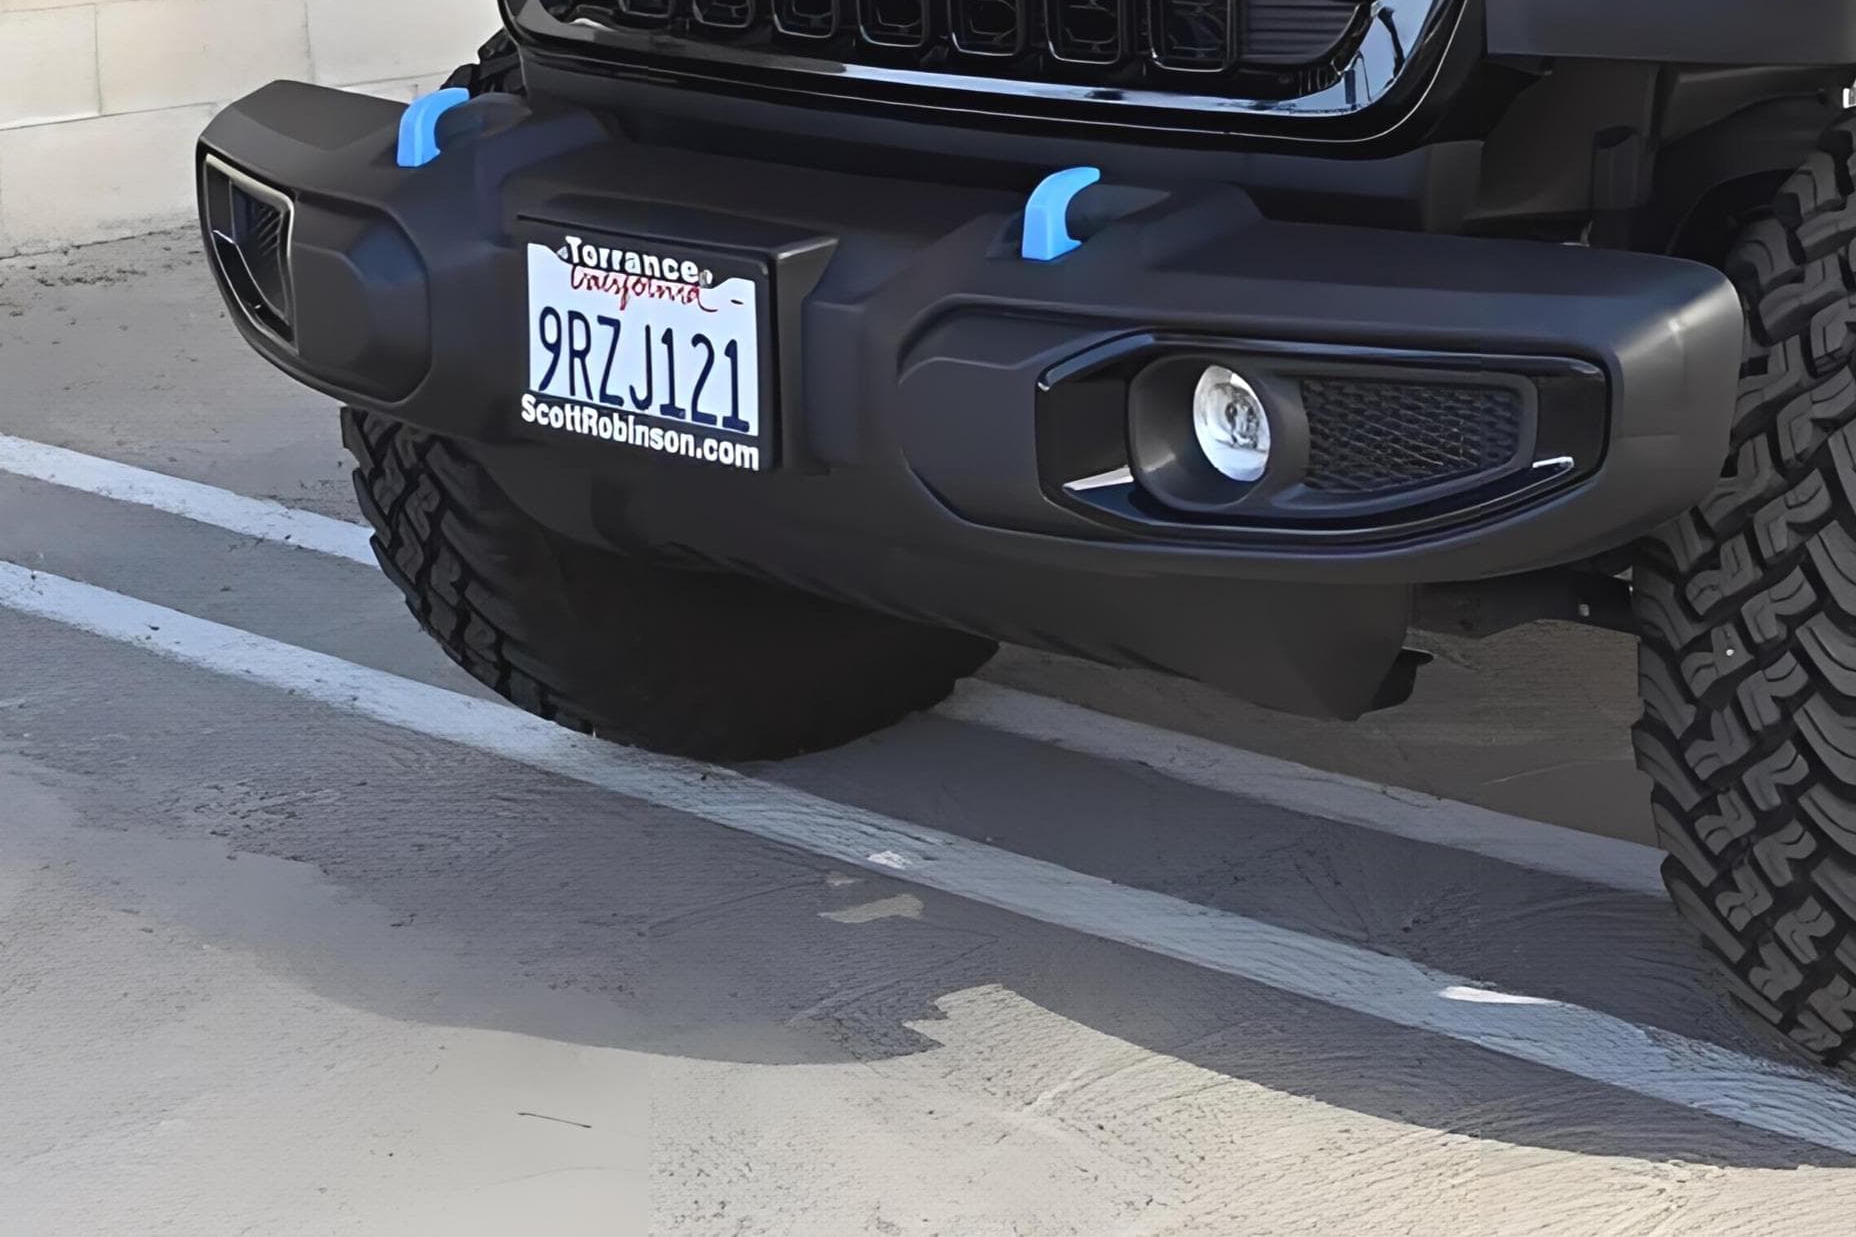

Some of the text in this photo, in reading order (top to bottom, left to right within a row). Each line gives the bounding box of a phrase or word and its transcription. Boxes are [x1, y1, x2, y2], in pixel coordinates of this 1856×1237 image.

[564, 235, 699, 284] Torrance
[537, 306, 751, 433] 9RZJ121
[520, 393, 760, 472] ScottRobinson.com
